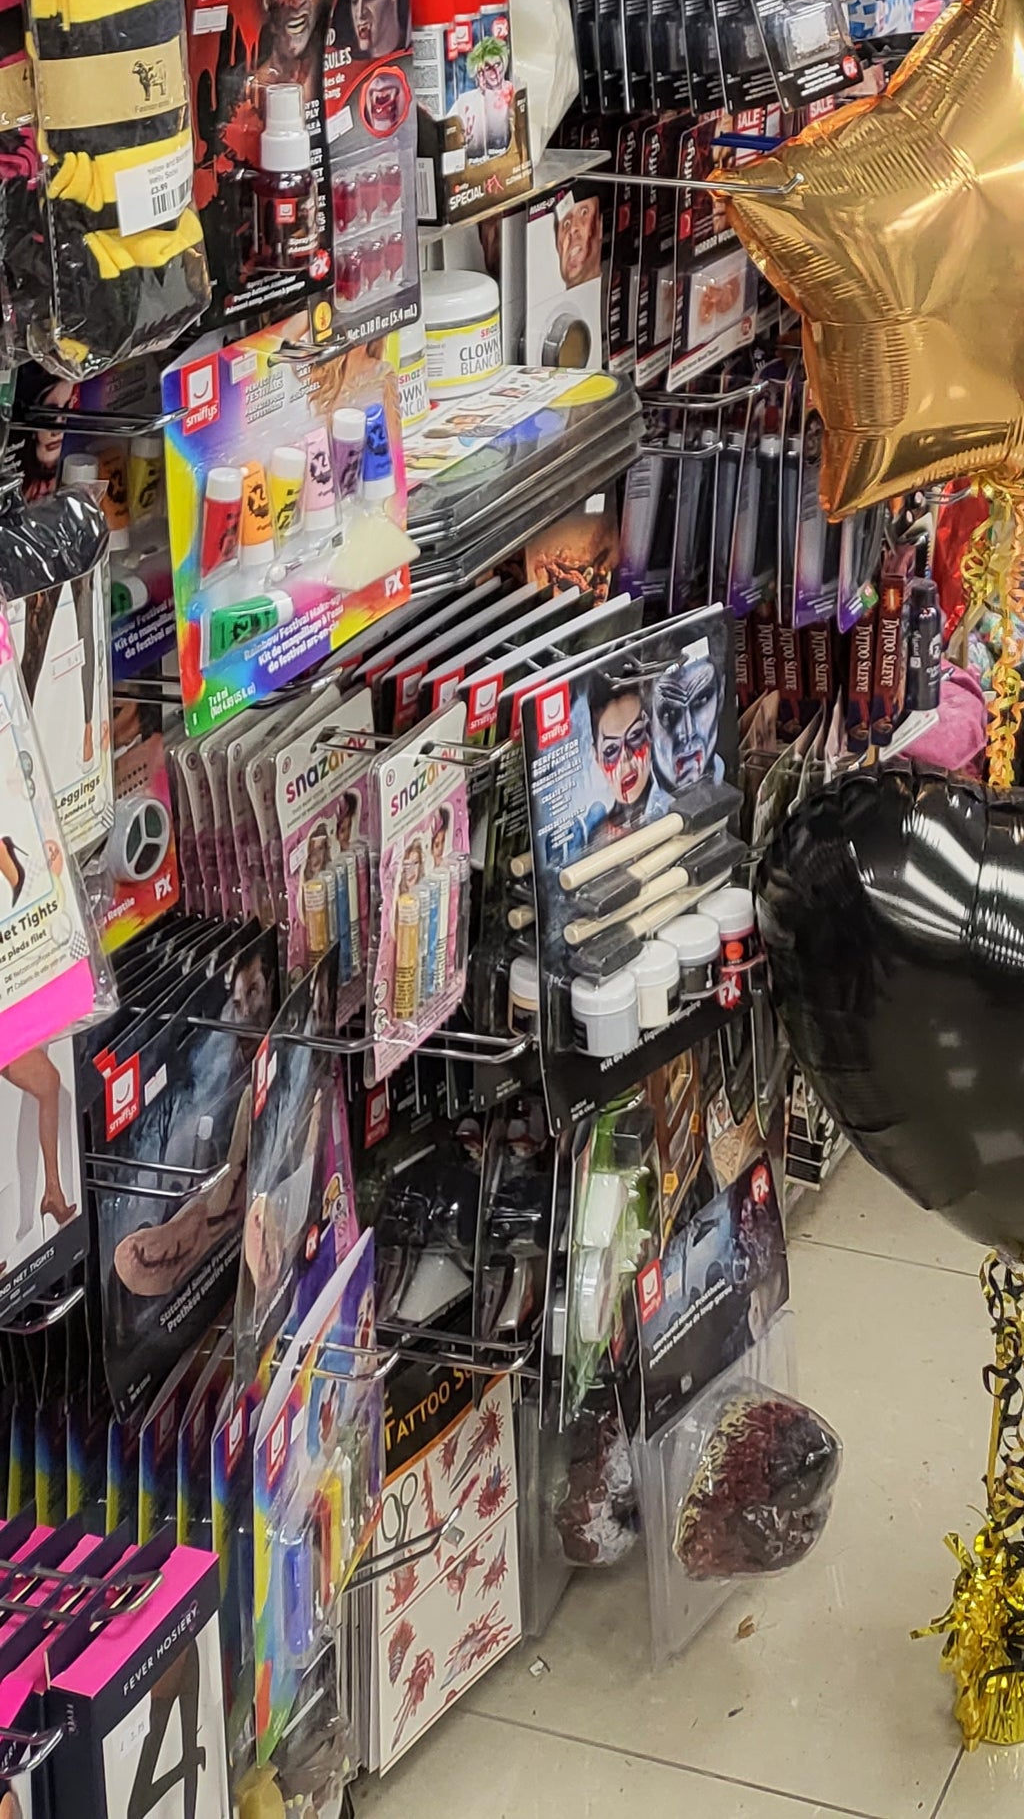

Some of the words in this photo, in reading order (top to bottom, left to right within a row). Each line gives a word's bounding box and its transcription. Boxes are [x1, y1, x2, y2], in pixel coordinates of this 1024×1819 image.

[324, 47, 352, 72] SULES
[305, 108, 320, 119] PLY
[810, 95, 834, 118] SALE
[450, 184, 484, 212] SPECIAL
[360, 320, 375, 336] 0.18
[481, 324, 499, 338] snaz
[460, 339, 499, 362] CLOWN
[399, 369, 421, 385] snaz
[461, 355, 490, 376] BLANC
[400, 383, 423, 404] OWN
[186, 402, 218, 428] smiffys
[114, 638, 127, 653] Kit
[127, 631, 139, 644] de
[243, 632, 279, 662] Rainbow
[278, 615, 310, 640] Festival
[811, 630, 828, 663] TATTOO
[856, 623, 873, 660] TATTOO
[881, 617, 899, 653] TATTOO
[124, 645, 136, 660] de
[258, 651, 271, 667] Kit
[271, 644, 282, 659] de
[267, 659, 278, 674] de
[278, 642, 306, 667] festival
[816, 663, 829, 693] SLEEVE
[855, 660, 872, 693] SLEEVE
[880, 653, 898, 687] SLEEVE
[541, 720, 570, 743] smiffys
[154, 873, 174, 902] FX
[20, 898, 59, 934] Tights
[107, 896, 136, 922] Reptile
[8, 939, 30, 963] pieds
[30, 929, 47, 950] filet
[109, 1103, 138, 1134] smiffys
[29, 1246, 56, 1273] TIGHTS
[159, 1288, 193, 1328] Stitched
[166, 1294, 200, 1333] Prothèse
[384, 1381, 451, 1452] TATTOO
[122, 1655, 155, 1697] FEVER
[156, 1605, 199, 1660] HOSIERY
